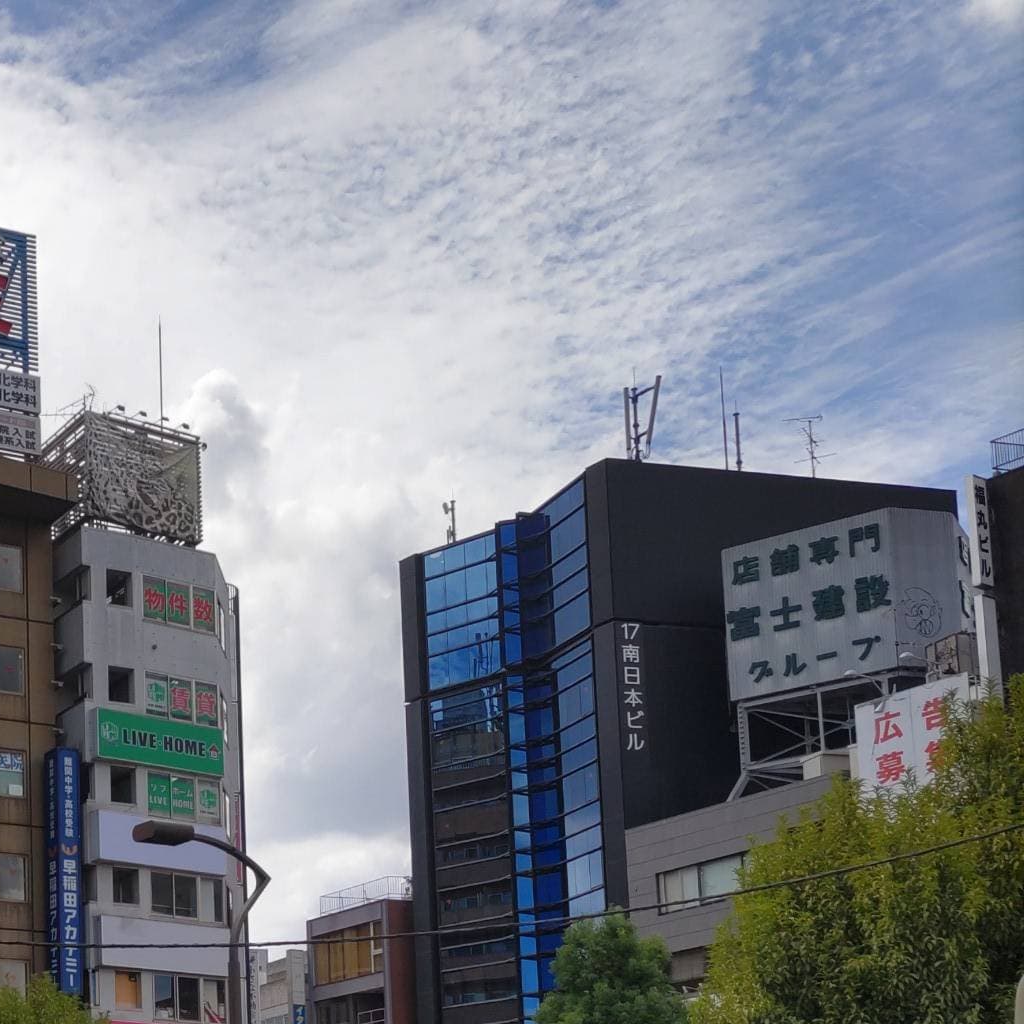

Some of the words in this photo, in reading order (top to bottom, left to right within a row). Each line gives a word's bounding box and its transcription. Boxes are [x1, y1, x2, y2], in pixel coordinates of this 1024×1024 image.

[732, 523, 881, 586] 店舗専門
[144, 587, 213, 623] 物件数
[726, 574, 893, 642] 富士建設
[748, 635, 881, 683] グループ
[171, 687, 216, 718] 賃貸
[874, 697, 949, 745] 広告
[122, 727, 157, 749] LIVE
[163, 734, 207, 758] HOME
